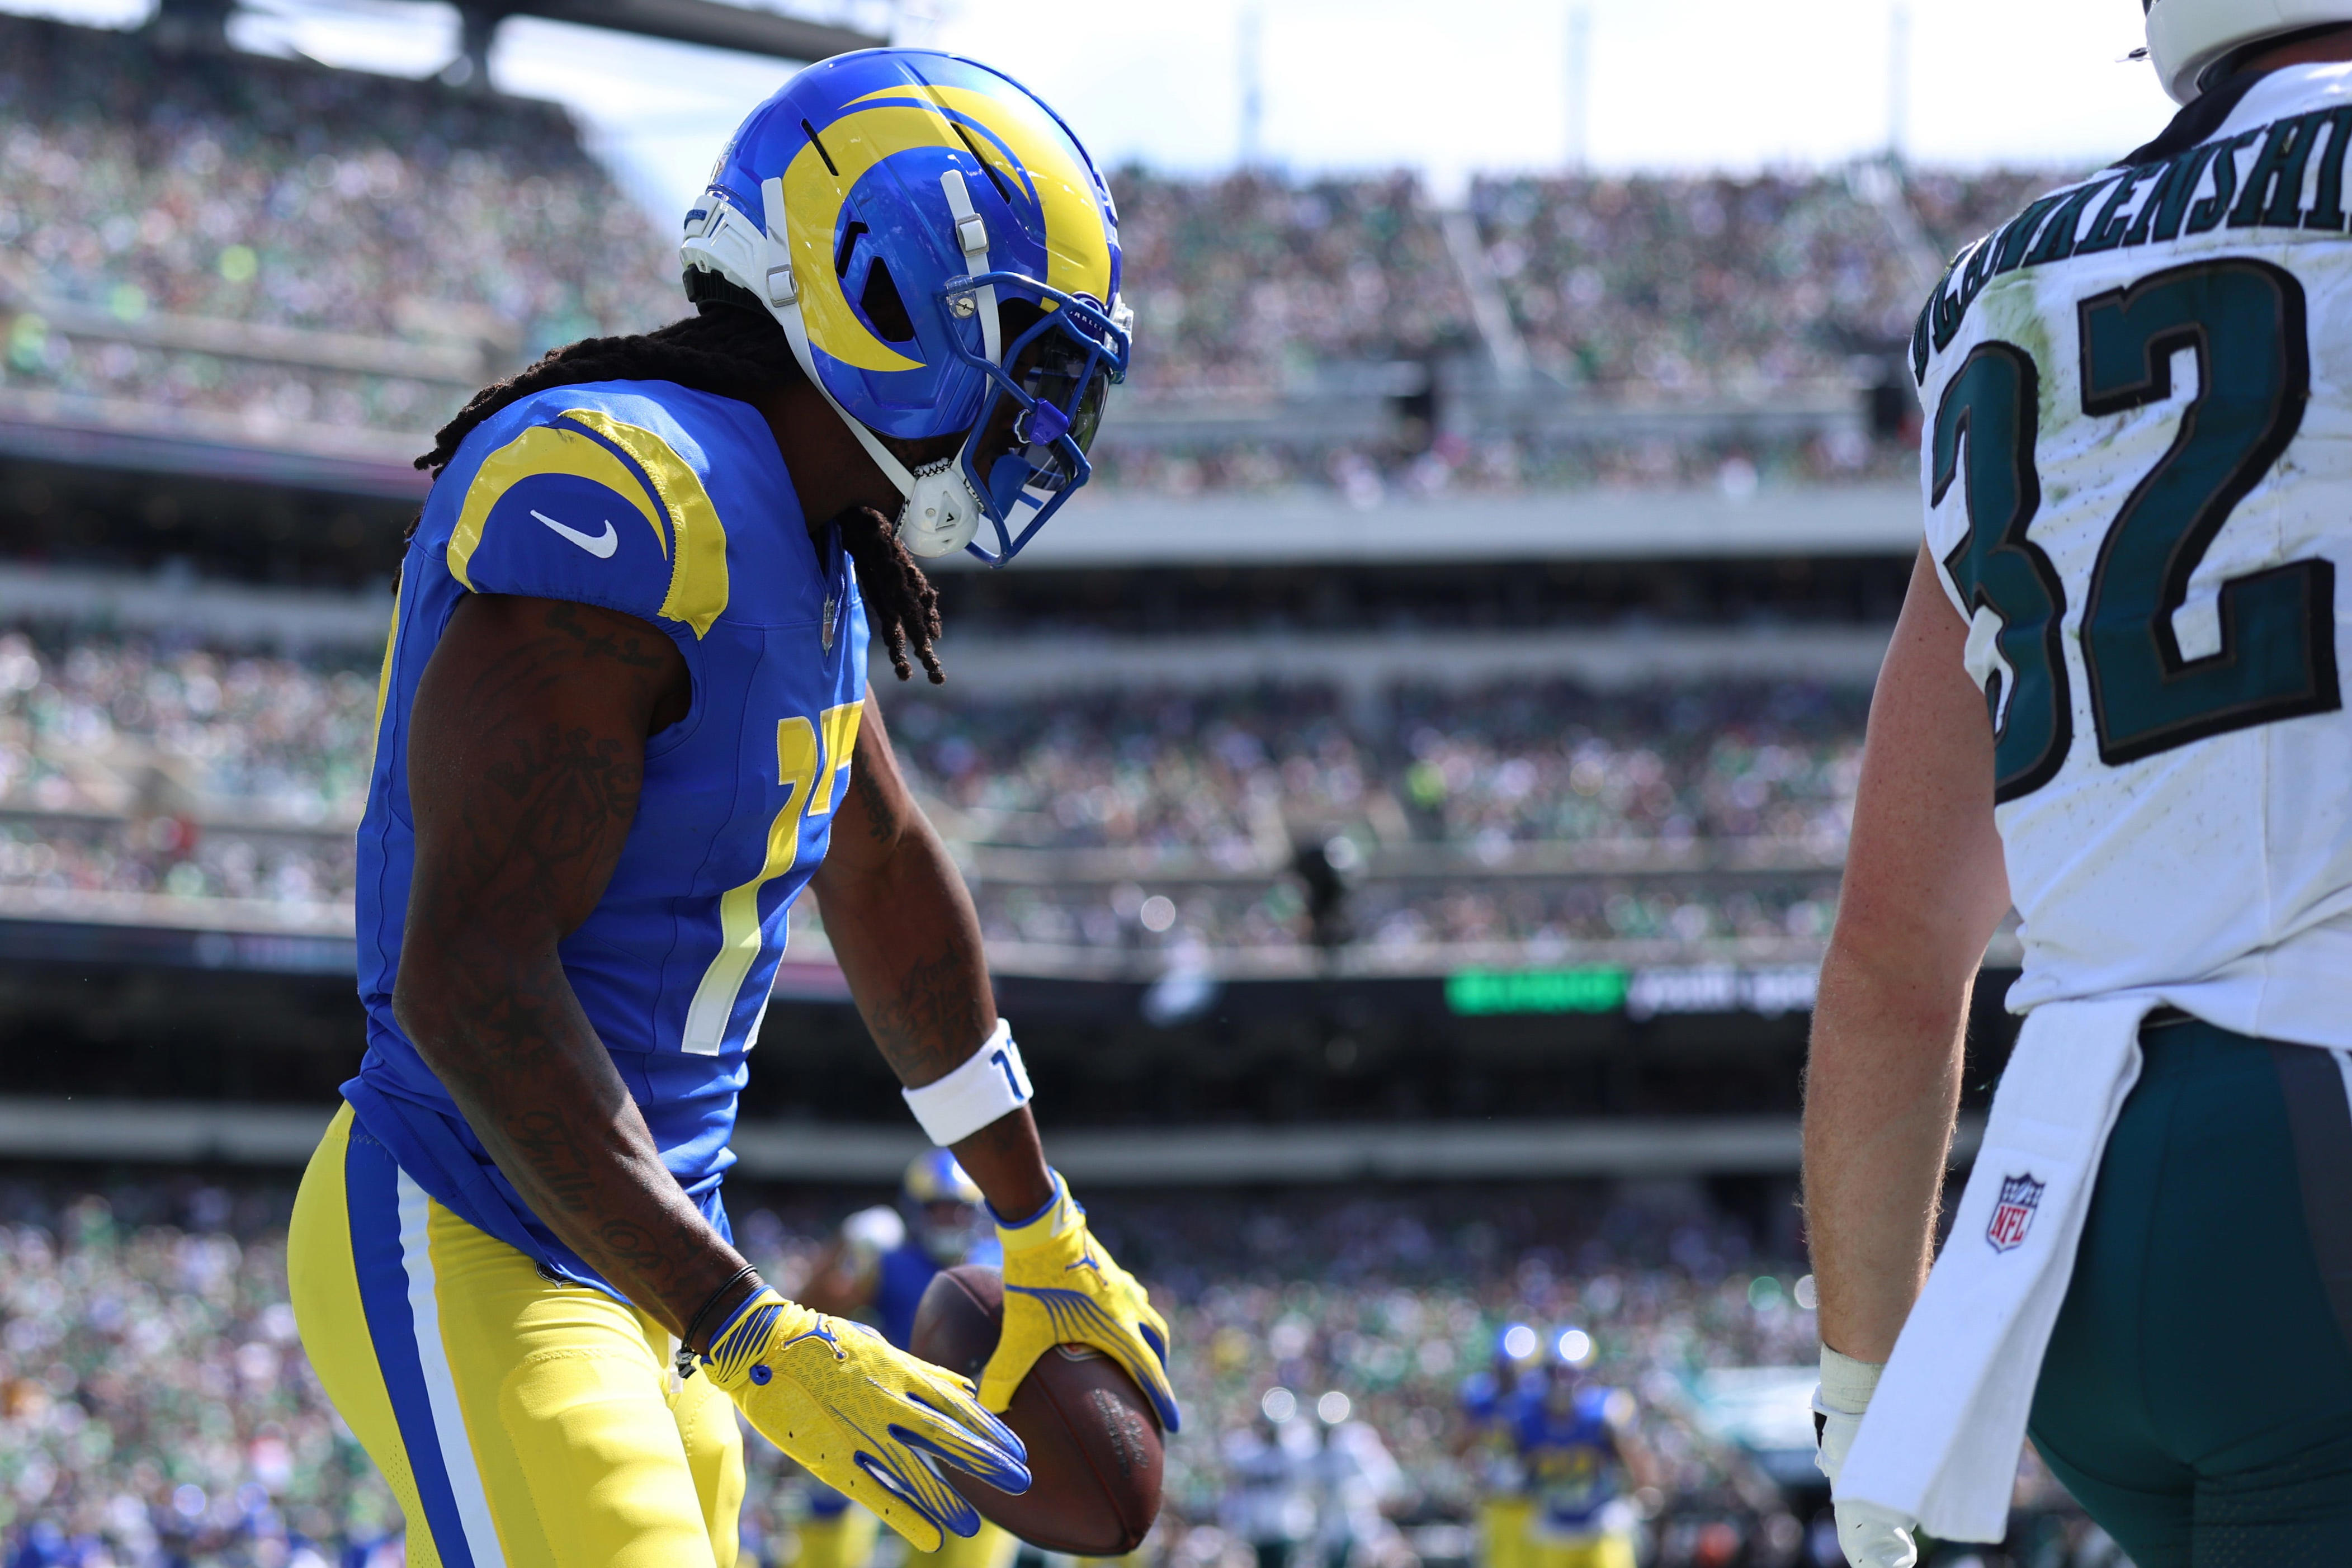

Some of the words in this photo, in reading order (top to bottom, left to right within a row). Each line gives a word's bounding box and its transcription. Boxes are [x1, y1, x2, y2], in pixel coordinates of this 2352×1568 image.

[1912, 105, 2352, 387] BLANKENSHI
[1930, 257, 2342, 804] 32
[1990, 1206, 2028, 1244] NFL
